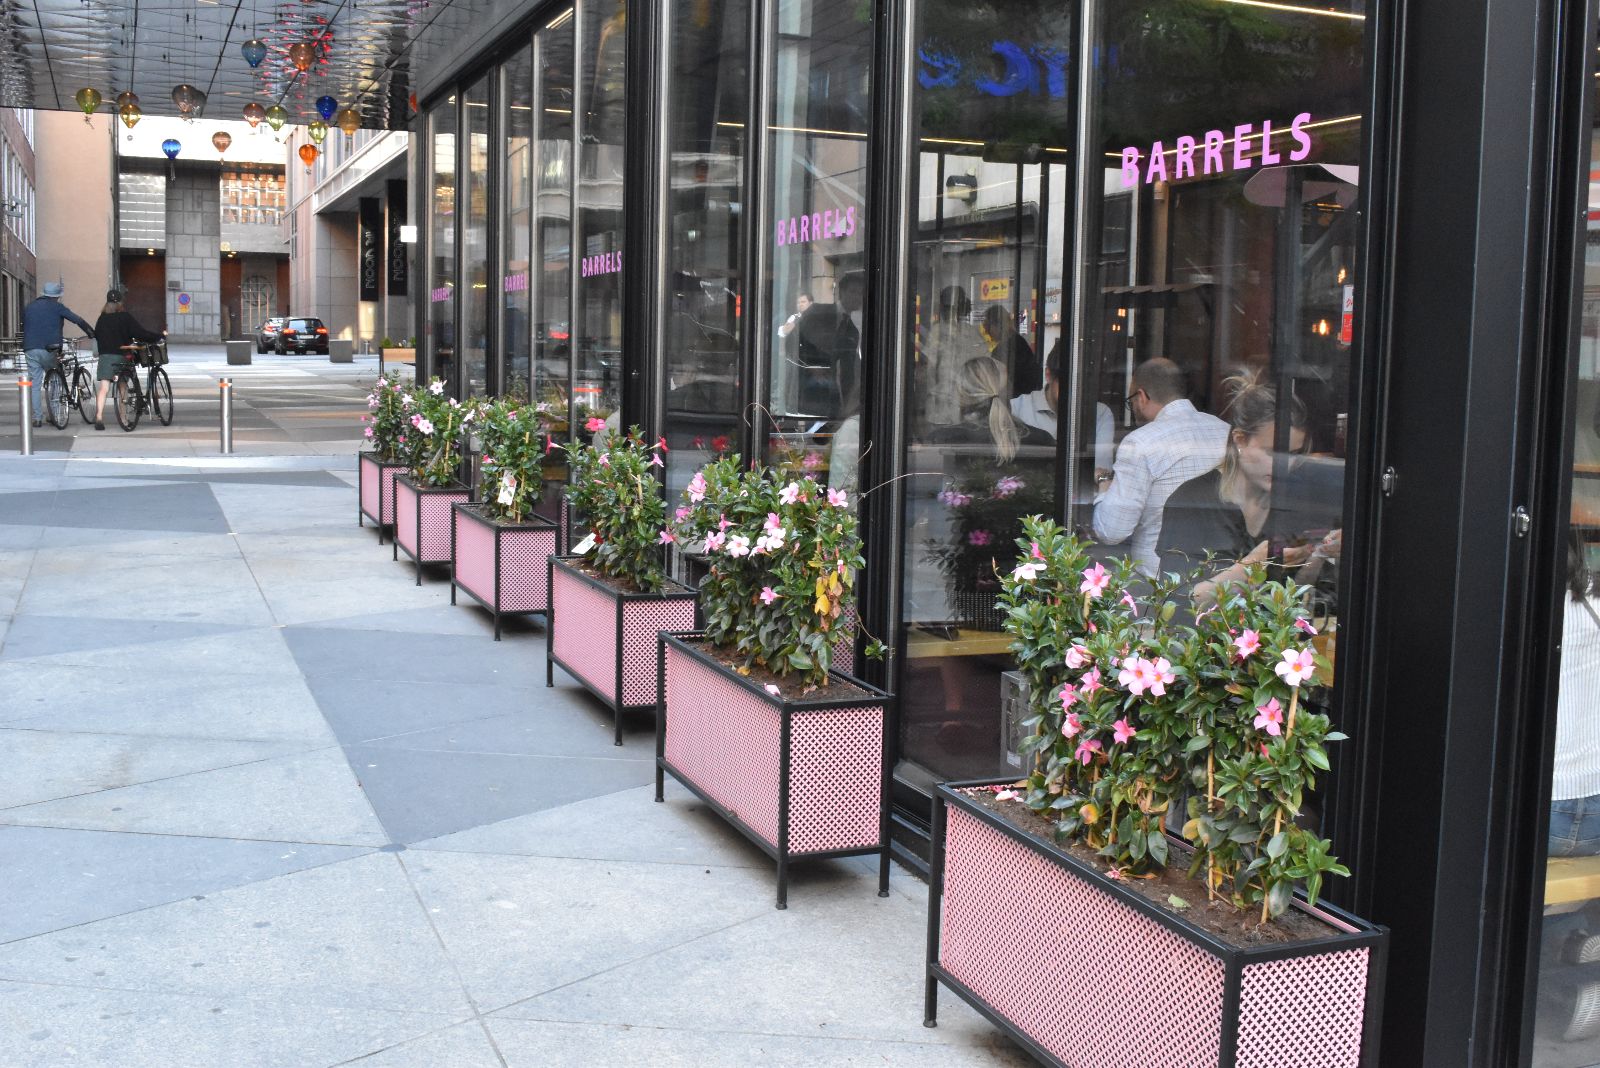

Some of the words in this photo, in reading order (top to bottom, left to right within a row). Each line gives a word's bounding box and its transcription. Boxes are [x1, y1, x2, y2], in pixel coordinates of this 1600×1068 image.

[1121, 112, 1312, 189] BARRELS
[777, 206, 855, 247] BARRELS
[582, 250, 622, 278] BARRELS
[504, 273, 529, 292] BARREL
